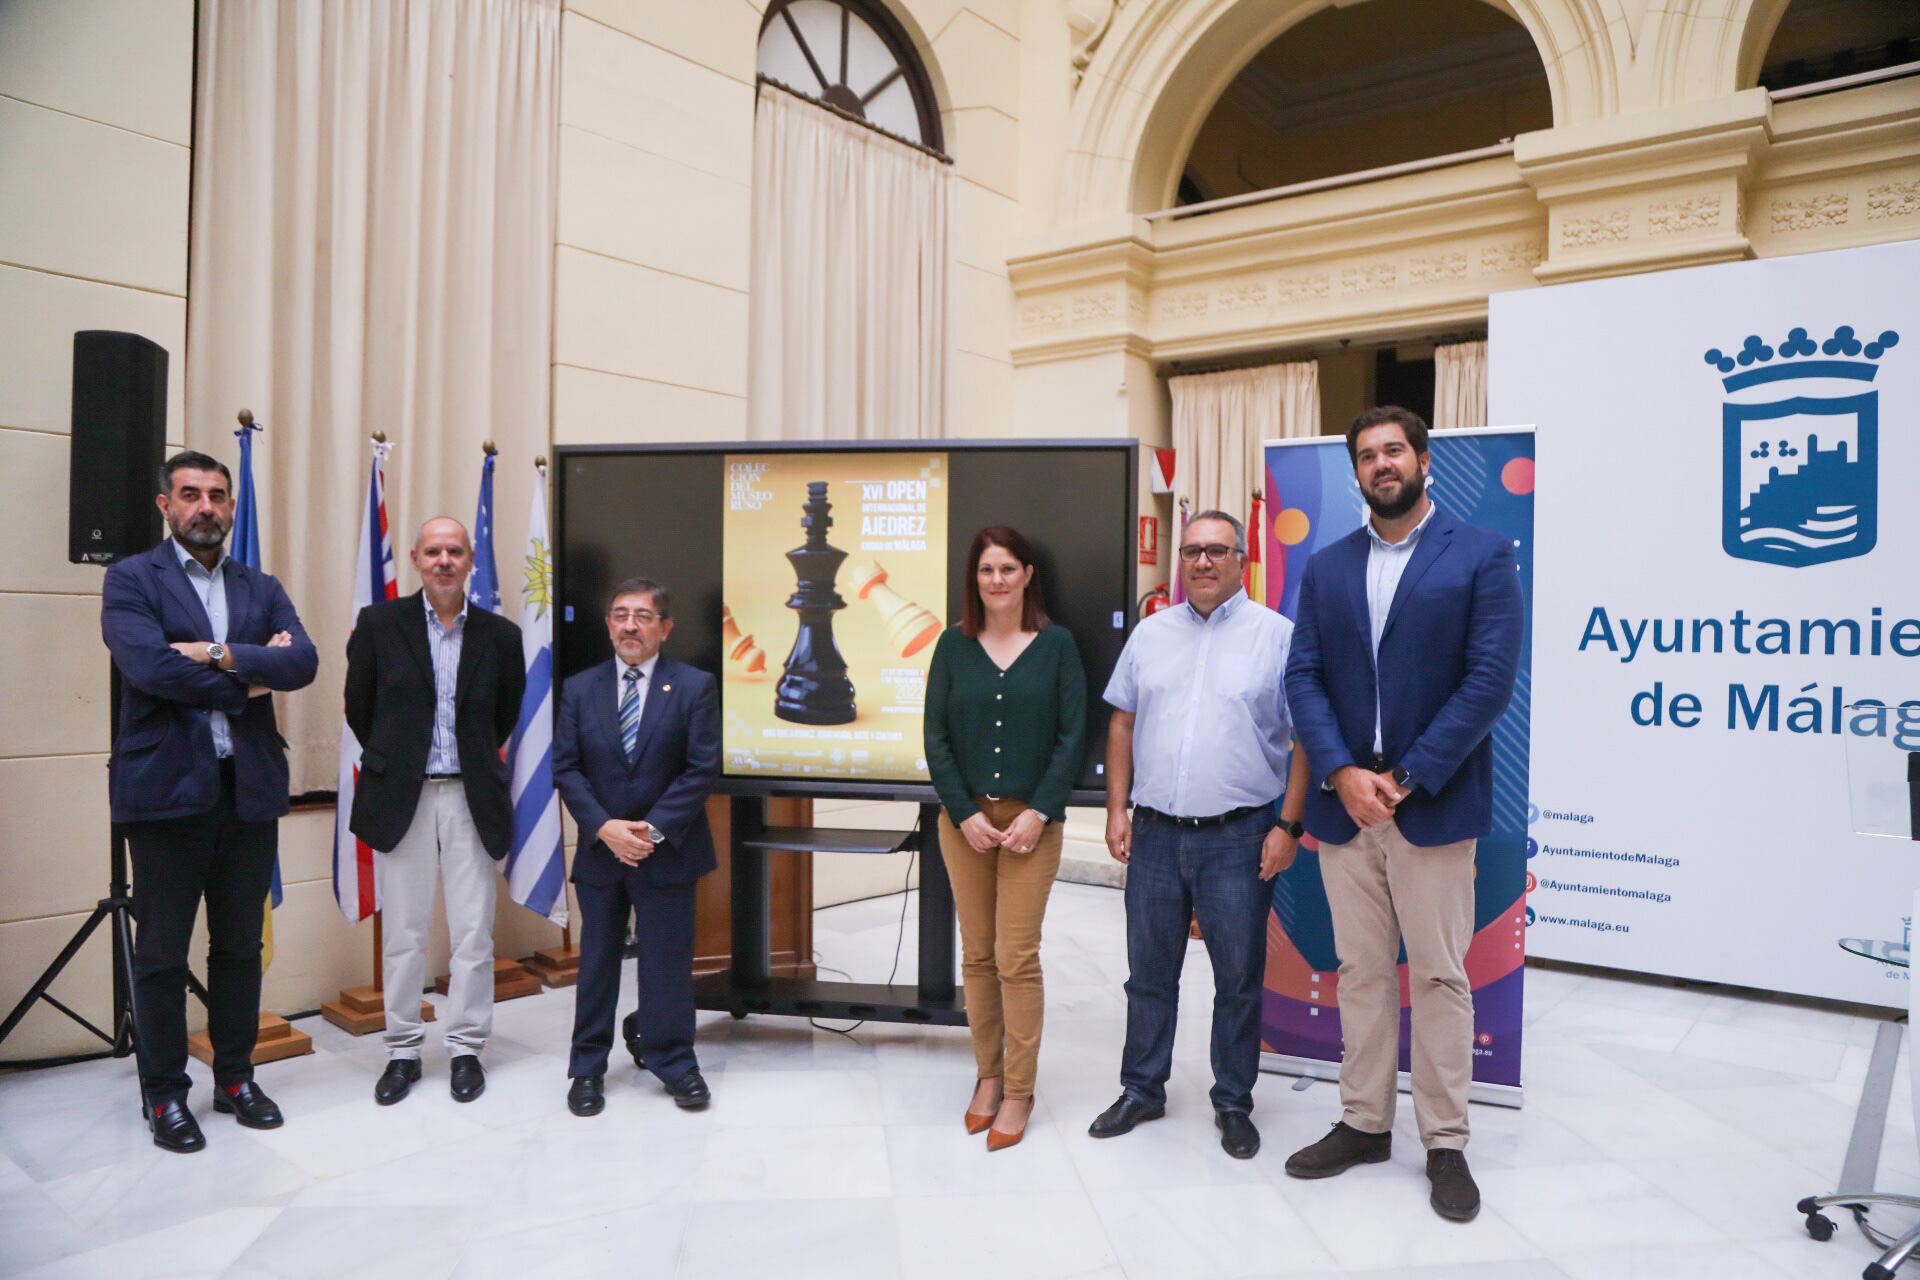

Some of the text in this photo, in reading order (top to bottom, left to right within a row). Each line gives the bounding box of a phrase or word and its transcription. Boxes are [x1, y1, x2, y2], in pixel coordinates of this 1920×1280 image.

[862, 480, 927, 500] XVI OPEN
[860, 516, 927, 536] AJEDREZ
[1630, 681, 1703, 728] de
[1543, 809, 1594, 824] @malaga
[1542, 844, 1680, 868] AyuntamientodeMalaga
[1540, 878, 1671, 903] @Ayuntamientomalaga
[1539, 914, 1629, 933] www.malaga.eu
